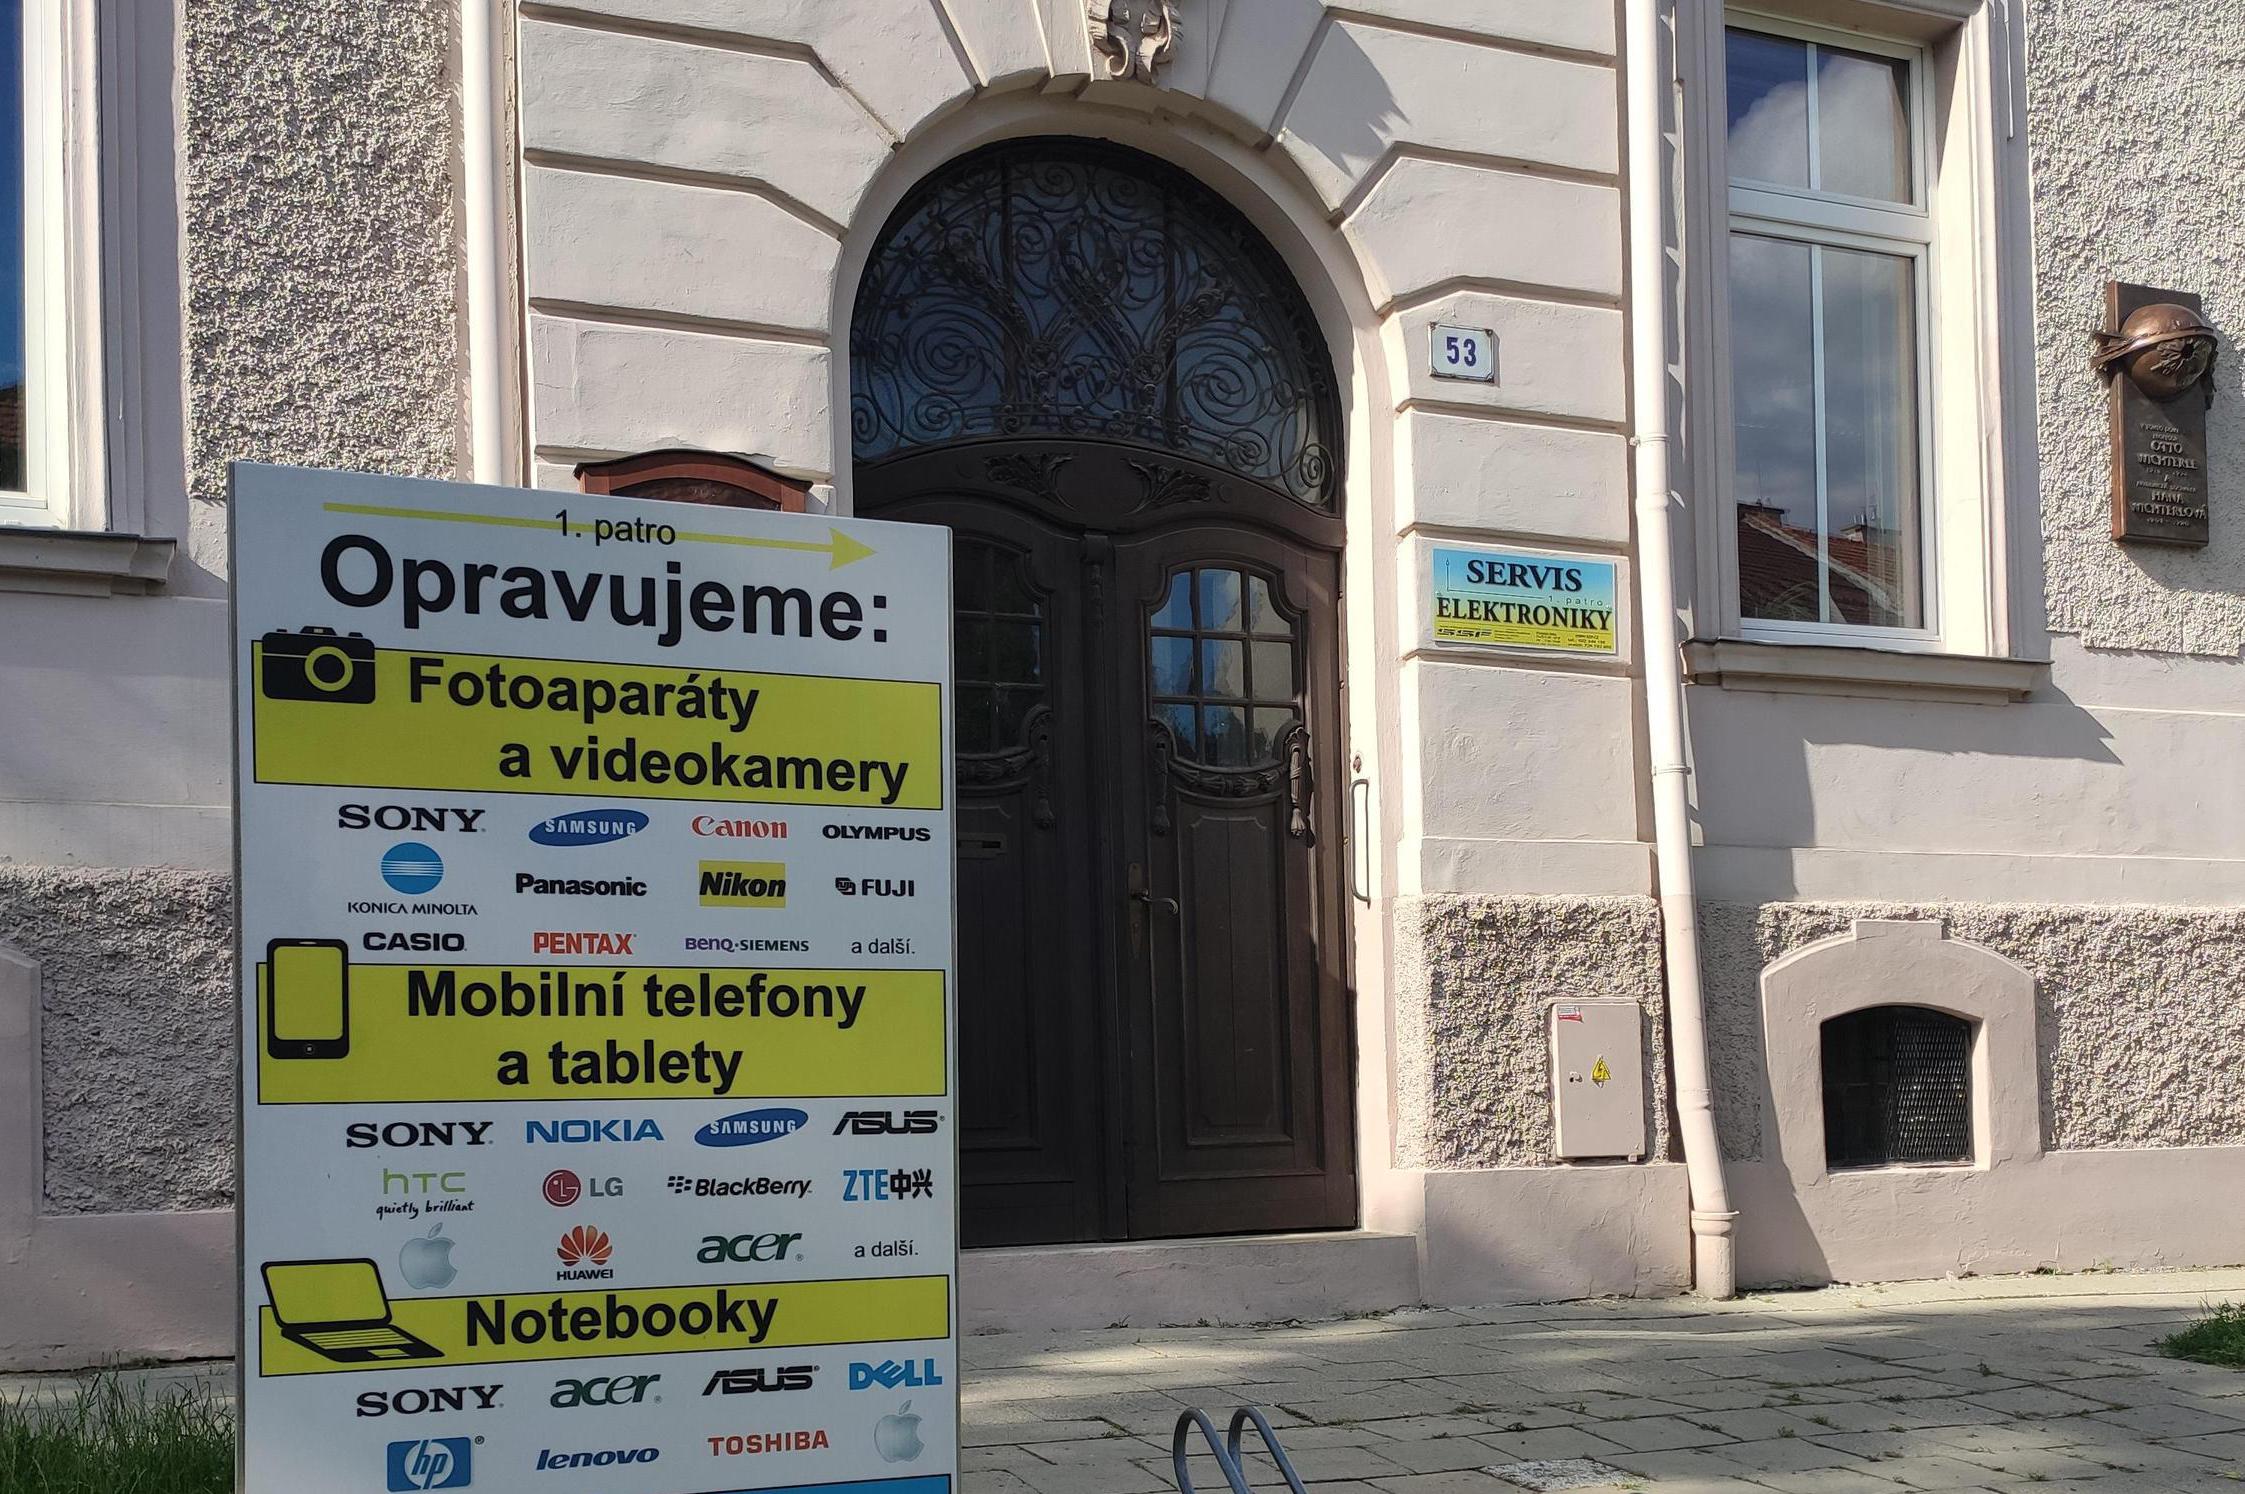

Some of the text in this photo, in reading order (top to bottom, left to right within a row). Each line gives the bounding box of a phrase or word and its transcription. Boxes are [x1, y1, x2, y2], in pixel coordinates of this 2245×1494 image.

[1446, 335, 1475, 366] 53
[2151, 440, 2182, 453] OTTO
[592, 510, 678, 546] patro
[1466, 559, 1582, 592] SERVIS
[320, 534, 889, 646] Opravujeme:
[1566, 597, 1604, 606] patro
[1436, 597, 1612, 630] ELEKTRONIKY
[408, 654, 761, 732] Fotoaparáty
[497, 736, 910, 805] a videokamery
[337, 803, 485, 833] SONY
[542, 817, 638, 837] SAMSUNG
[691, 813, 790, 840] Canon
[821, 824, 931, 843] OLYMPUS
[515, 872, 648, 898] Panasonic
[700, 870, 787, 899] Nikon
[860, 877, 916, 899] FUJI
[347, 900, 479, 917] KONICA MINOLTA
[362, 930, 464, 953] CASIO
[533, 932, 634, 956] PENTAX
[850, 936, 916, 956] a další.
[406, 969, 867, 1029] Mobilní telefony
[495, 1040, 744, 1096] a tablety
[345, 1120, 492, 1148] SONY
[526, 1118, 665, 1144] NOKIA
[709, 1117, 798, 1136] SAMSUNG
[382, 1167, 466, 1195] htc
[589, 1176, 624, 1199] LG
[695, 1176, 809, 1199] BlackBerry
[375, 1199, 475, 1221] quietly brilliant
[696, 1231, 802, 1265] acer
[853, 1238, 920, 1259] a další.
[556, 1268, 614, 1281] HUAWEI
[465, 1288, 779, 1348] Notebooky
[848, 1357, 943, 1390] DELL
[355, 1383, 505, 1417] SONY
[549, 1372, 661, 1409] acer
[708, 1430, 829, 1458] TOSHIBA
[535, 1445, 661, 1471] lenovo
